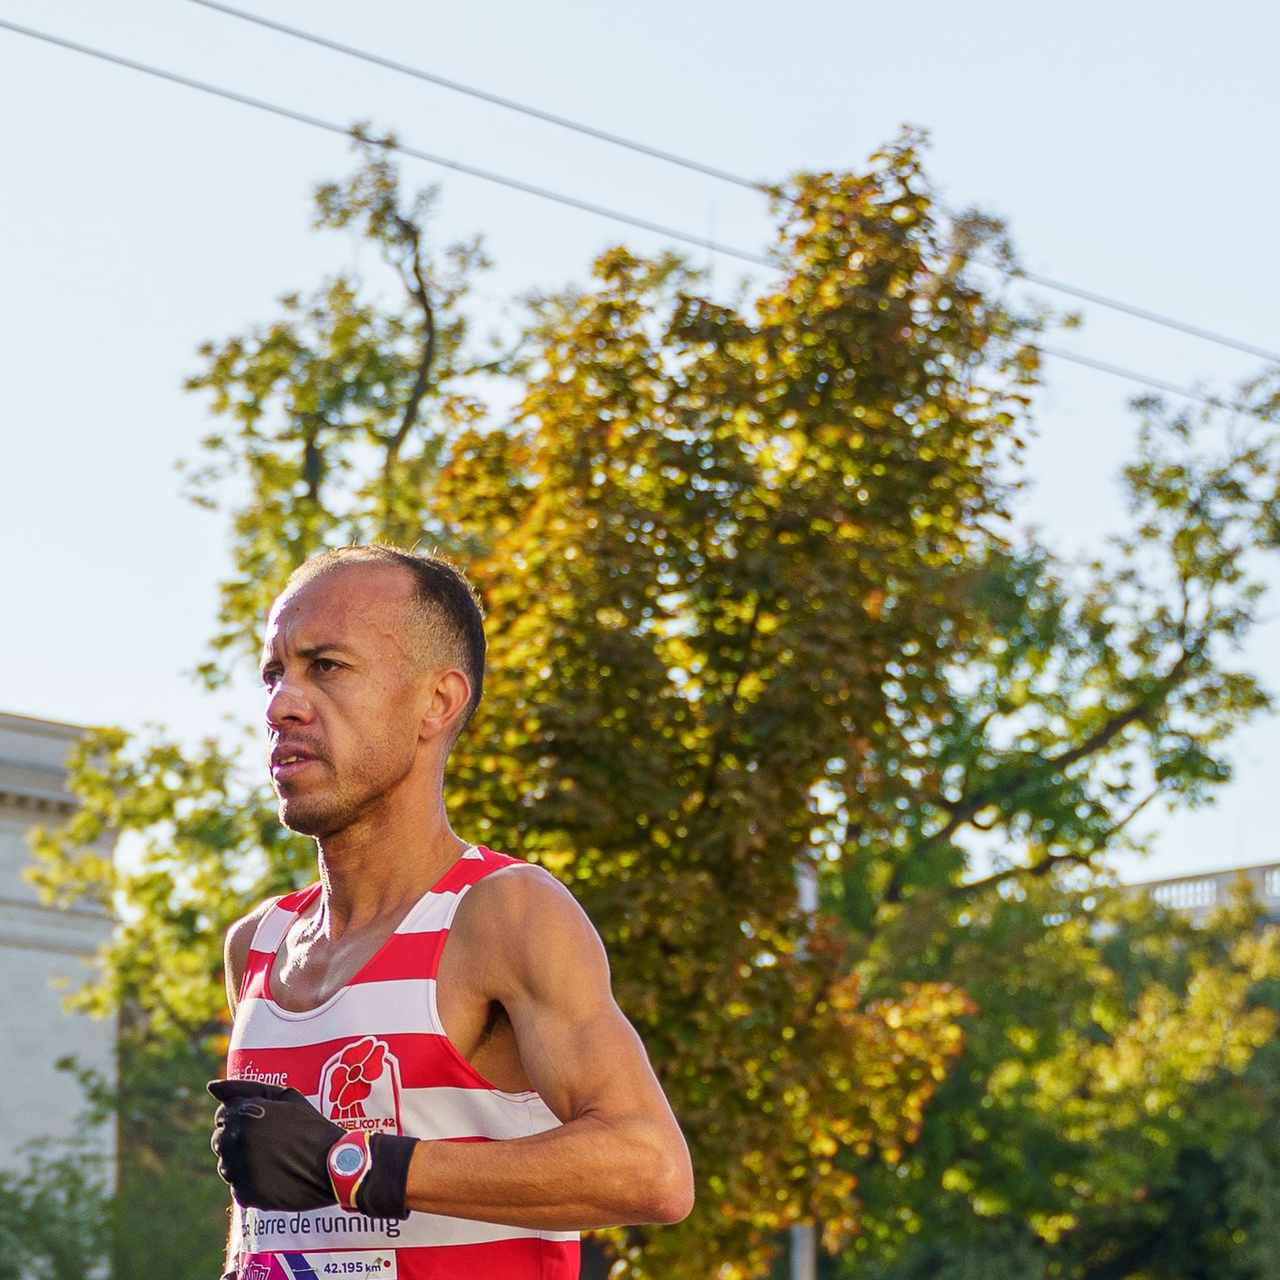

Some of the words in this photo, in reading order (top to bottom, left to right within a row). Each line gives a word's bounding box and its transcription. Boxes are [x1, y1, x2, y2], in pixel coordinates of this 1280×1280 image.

[382, 1117, 396, 1128] 42
[254, 1216, 286, 1236] terre
[289, 1211, 311, 1235] de
[315, 1216, 401, 1239] running
[323, 1262, 363, 1274] 42.195
[365, 1262, 382, 1273] km
